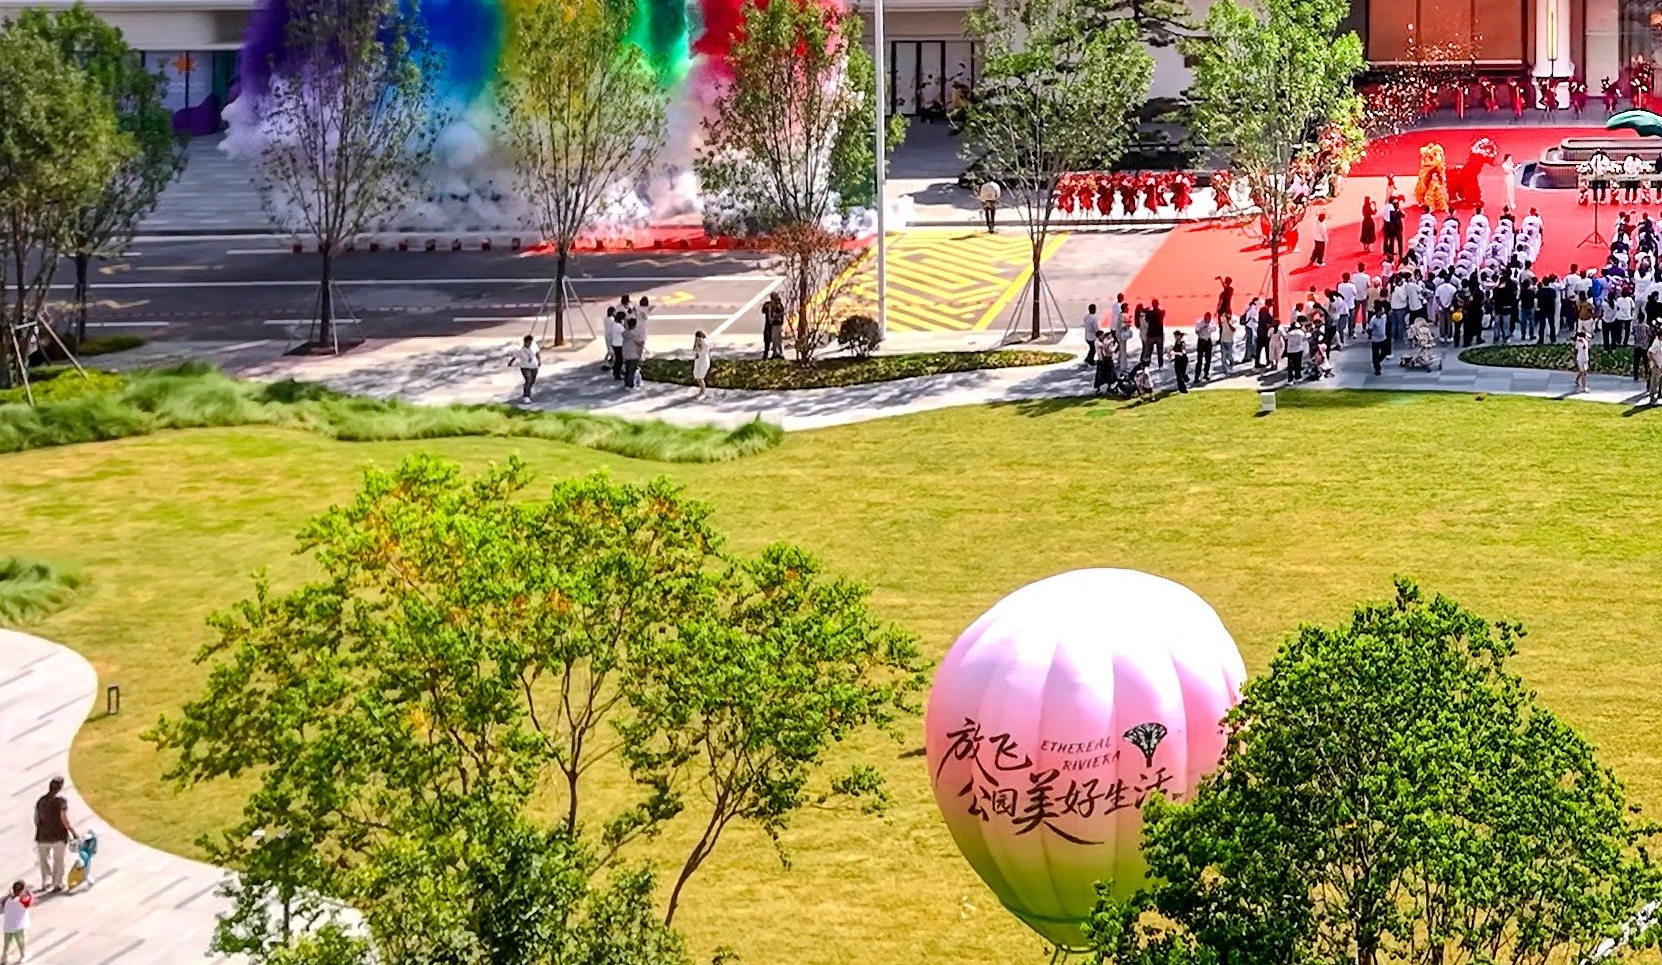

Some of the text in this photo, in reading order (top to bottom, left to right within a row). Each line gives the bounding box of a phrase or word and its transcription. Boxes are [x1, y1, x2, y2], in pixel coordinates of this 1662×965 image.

[936, 717, 1034, 787] 放飞
[1040, 736, 1112, 754] ETHEREAL
[1062, 750, 1121, 772] RIVIERA
[957, 766, 1174, 846] 公园美好生活
